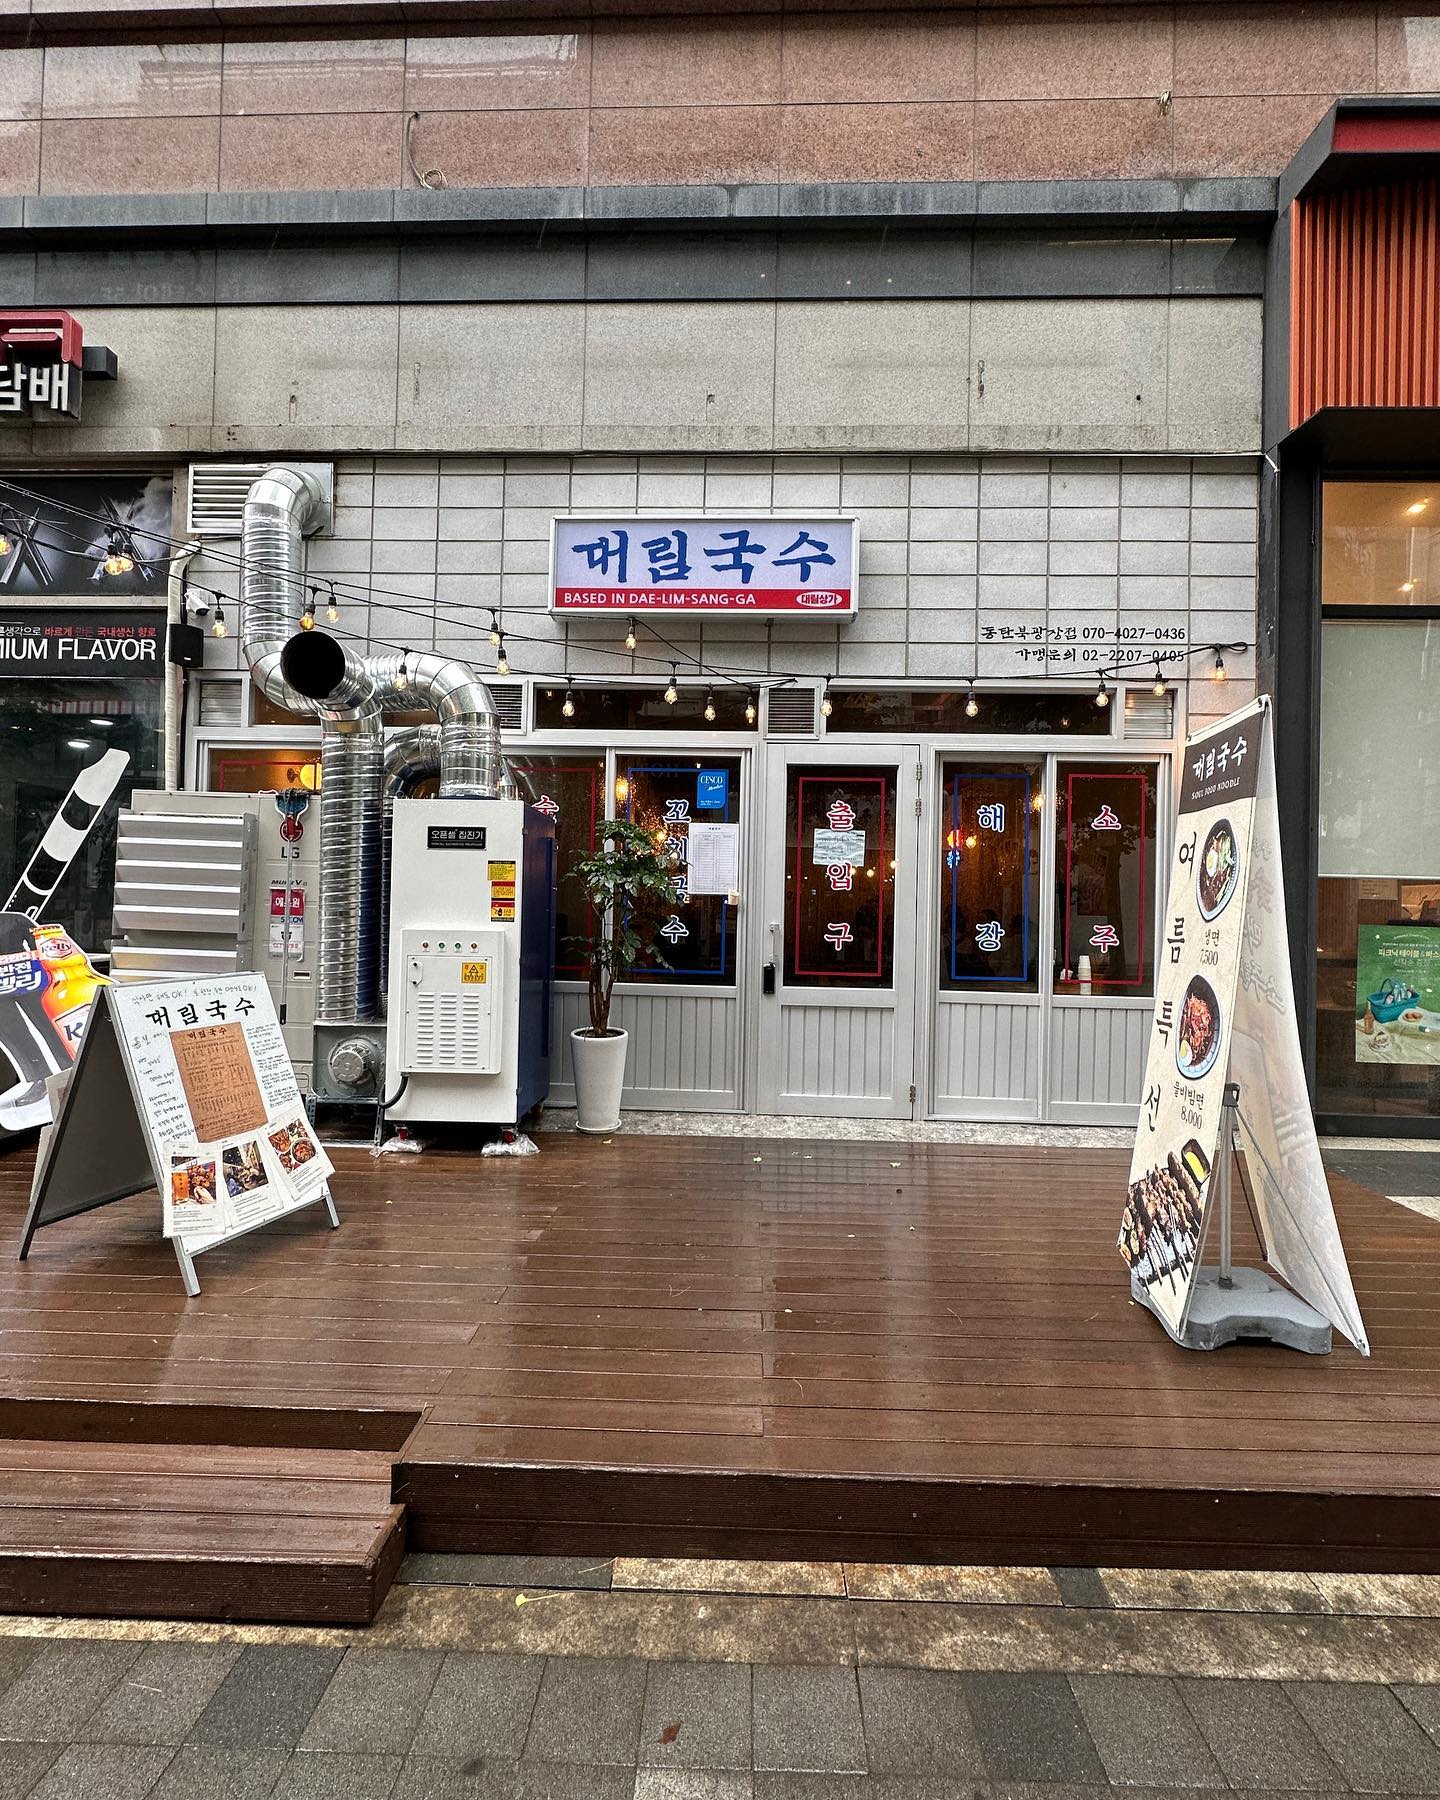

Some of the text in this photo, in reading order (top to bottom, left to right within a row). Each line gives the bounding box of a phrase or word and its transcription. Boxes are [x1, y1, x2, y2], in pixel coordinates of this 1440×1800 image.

[0, 363, 69, 411] 담배
[572, 530, 836, 583] 대림국수
[564, 593, 756, 605] BASED IN DAE-LIM-SANG-GA
[44, 627, 72, 637] 바르게
[98, 627, 134, 637] 국내생산
[981, 626, 1185, 640] 동탄북광장점 070-4027-0436
[0, 638, 157, 660] IUM FLAVOR
[1015, 648, 1184, 662] 가맹문의 02-2207-0405
[1192, 736, 1248, 781] 대림국수
[1216, 776, 1241, 791] NOODLE
[458, 830, 484, 840] 집진기
[281, 846, 300, 859] LG
[824, 799, 856, 951] 출입구
[975, 802, 1005, 951] 해장
[1089, 804, 1122, 954] 소주
[281, 915, 304, 923] SCOM
[41, 942, 72, 954] Kelly
[145, 997, 255, 1028] 대림국수
[1181, 1105, 1203, 1130] 8,000
